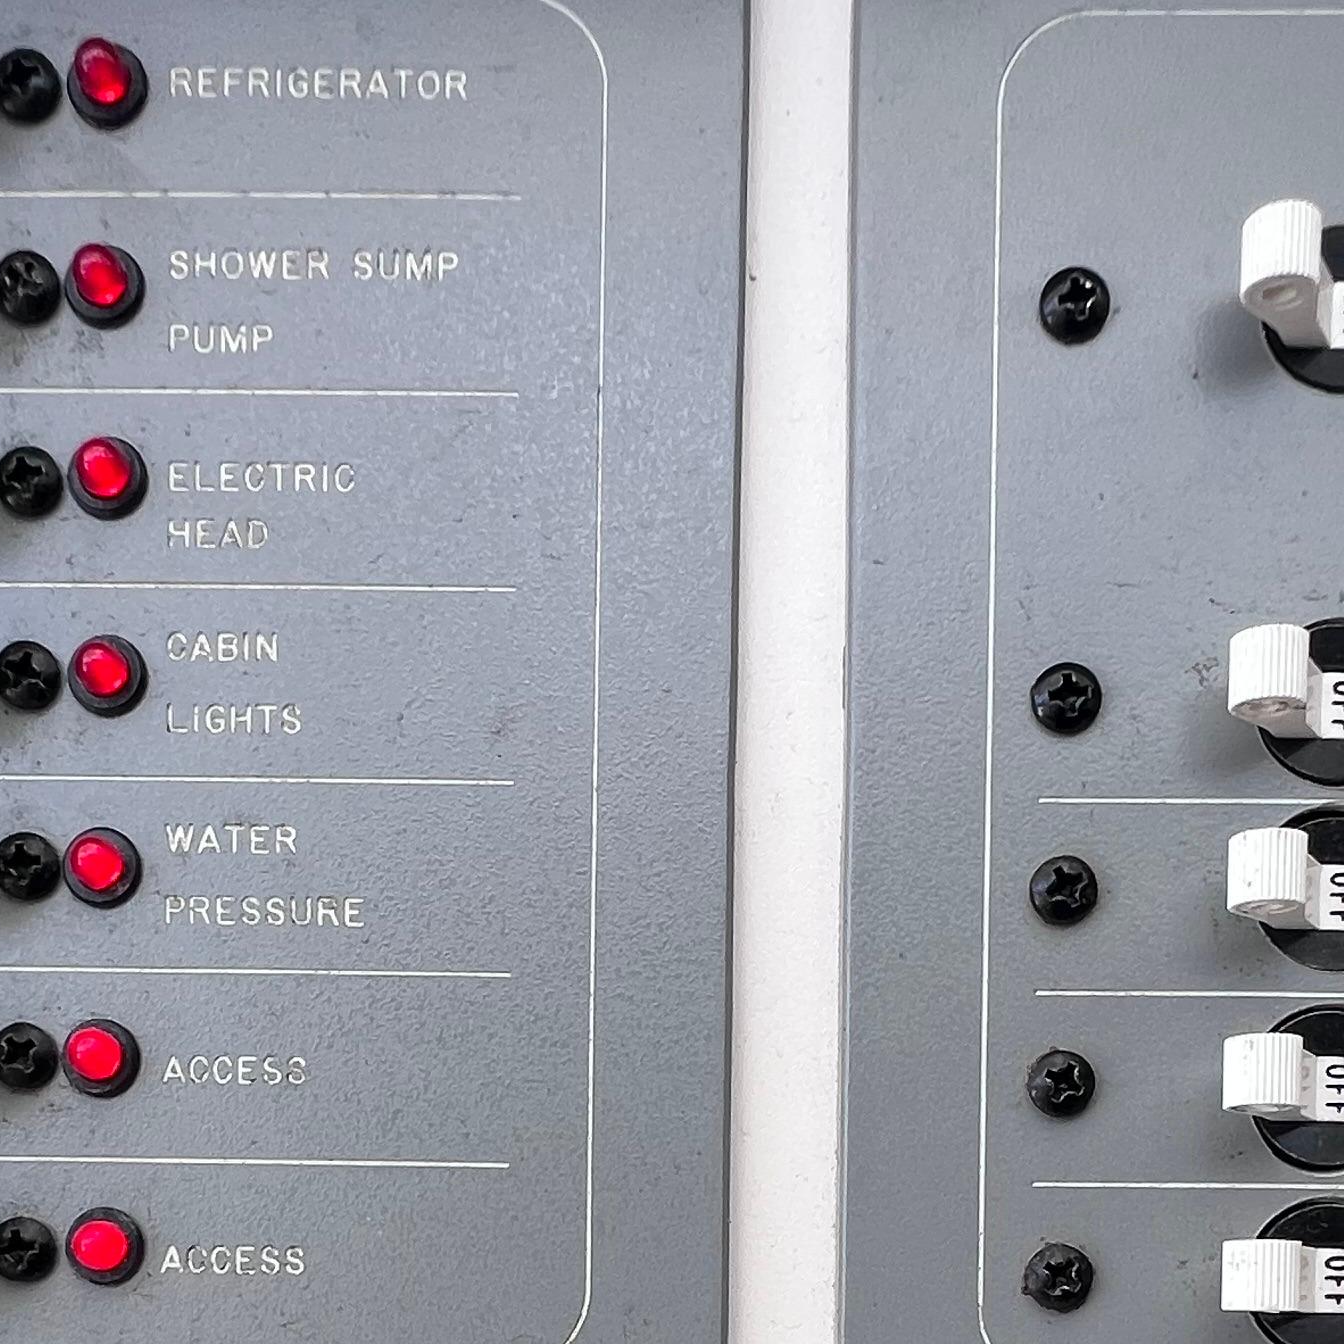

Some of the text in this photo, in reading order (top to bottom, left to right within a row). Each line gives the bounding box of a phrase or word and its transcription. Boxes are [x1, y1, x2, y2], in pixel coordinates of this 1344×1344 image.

[168, 67, 469, 99] REFRIGERATOR
[168, 250, 461, 283] SHOWER SUMP
[168, 325, 275, 354] PUMP
[167, 463, 357, 494] ELECTRIC
[167, 520, 270, 550] HEAD
[166, 632, 280, 663] CABIN
[166, 704, 303, 736] LIGHTS
[165, 825, 299, 856] WATER
[164, 896, 366, 929] PRESSURE
[162, 1055, 308, 1087] ACCESS
[160, 1245, 306, 1277] ACCESS
